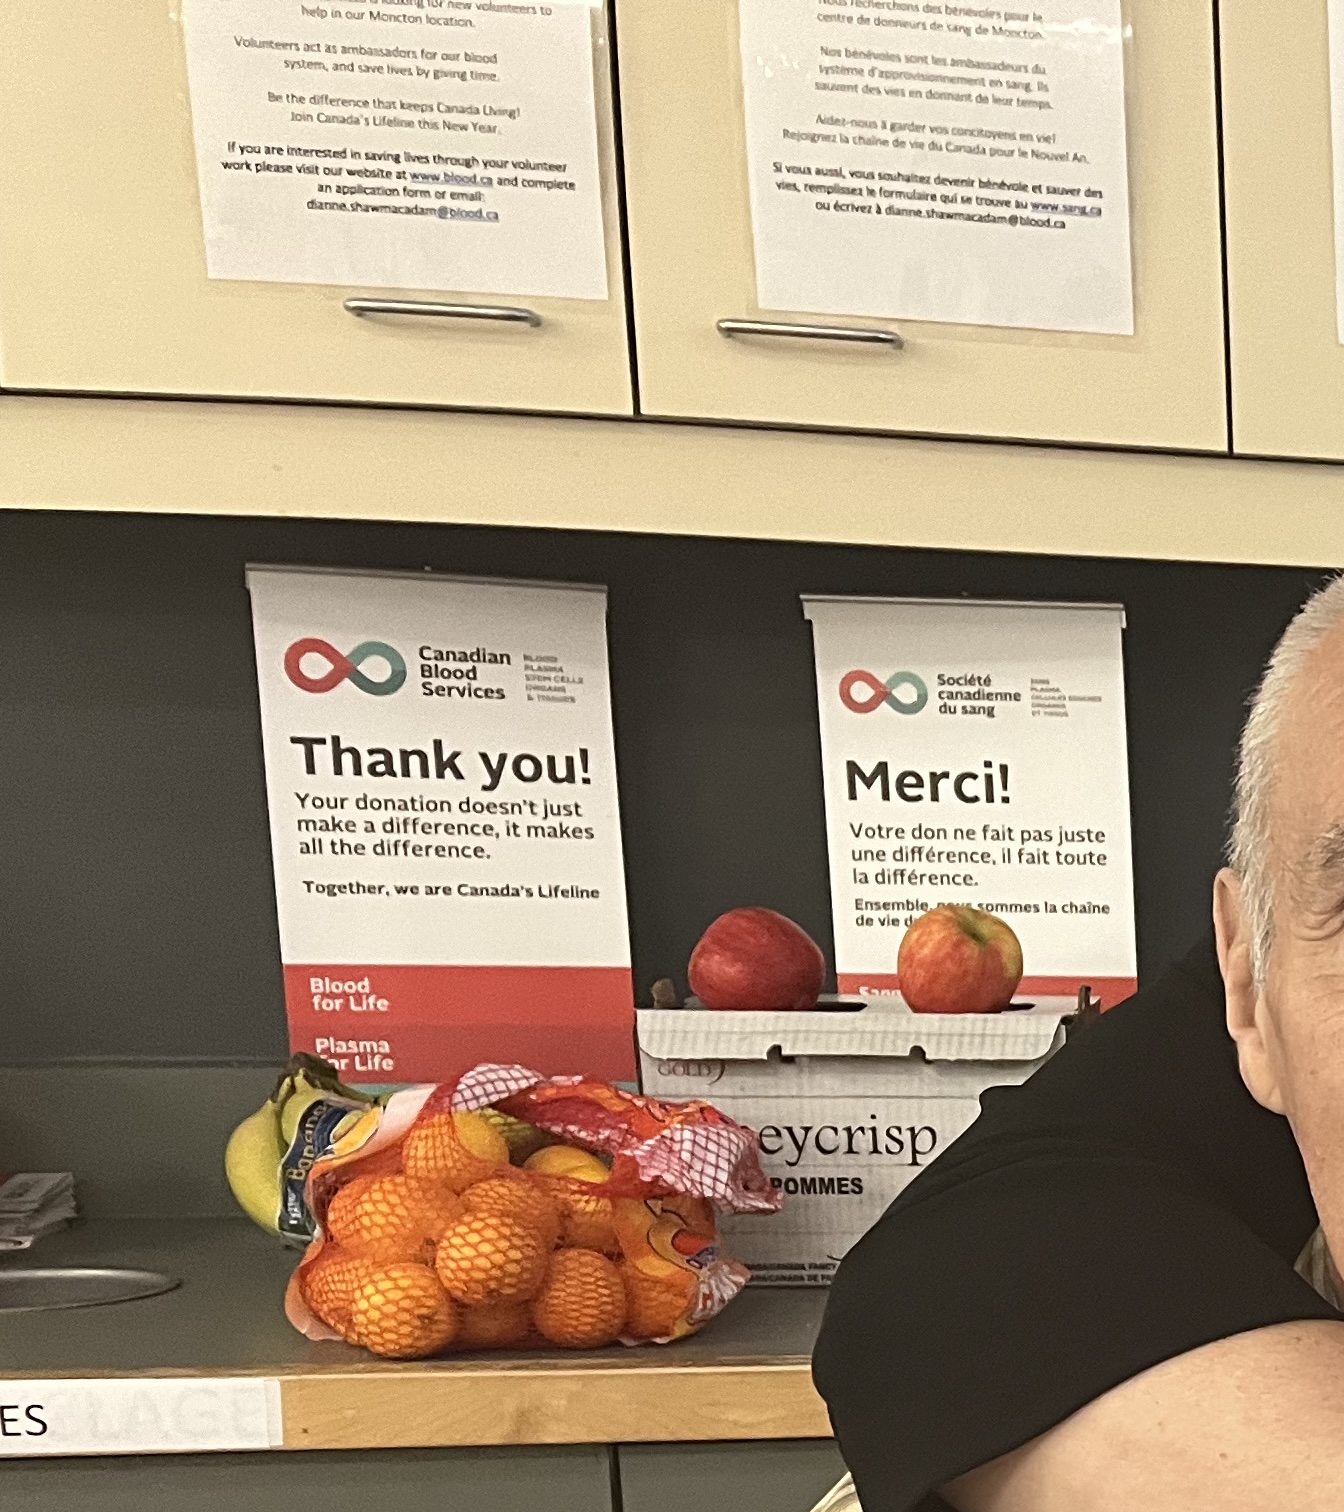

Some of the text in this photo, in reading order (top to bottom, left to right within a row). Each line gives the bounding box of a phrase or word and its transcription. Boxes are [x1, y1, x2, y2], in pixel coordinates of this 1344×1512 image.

[301, 5, 327, 19] help
[331, 8, 341, 18] in
[345, 11, 364, 19] our
[370, 10, 422, 23] Moncton
[234, 36, 300, 50] Volunteers
[228, 143, 566, 172] If you are interested in saving lives through your volunteer
[221, 161, 252, 171] work
[255, 162, 292, 174] please
[296, 164, 319, 175] visit
[323, 168, 342, 176] our
[346, 168, 392, 179] website
[396, 170, 406, 180] at
[497, 177, 517, 187] and
[522, 179, 575, 191] complete
[318, 185, 331, 193] an
[336, 185, 399, 197] application
[403, 187, 430, 199] form
[419, 646, 511, 666] Canadian
[420, 664, 477, 680] Blood
[937, 673, 992, 687] Société
[422, 682, 506, 700] Services
[938, 689, 1022, 702] canadienne
[939, 702, 995, 718] du sang
[290, 735, 591, 791] Thank you!
[846, 760, 1010, 803] Merci!
[295, 792, 583, 818] Your donation doesn't just
[297, 816, 594, 839] make a difference, it makes
[850, 823, 1106, 845] Votre don ne fait pas juste
[299, 839, 491, 859] all the difference.
[852, 846, 1108, 866] une différence, il fait toute
[853, 868, 979, 886] la différence.
[302, 880, 600, 899] Together, we are Canada's Lifeline
[977, 903, 1040, 914] sommes
[1044, 901, 1058, 913] la
[1062, 901, 1110, 914] chaîne
[856, 915, 874, 926] de
[878, 915, 900, 926] vie
[310, 977, 370, 993] Blood
[313, 995, 389, 1012] for Life
[316, 1036, 390, 1054] Plasma
[355, 1054, 394, 1071] Life
[758, 1114, 938, 1166] eycrisp
[0, 1404, 48, 1437] ES
